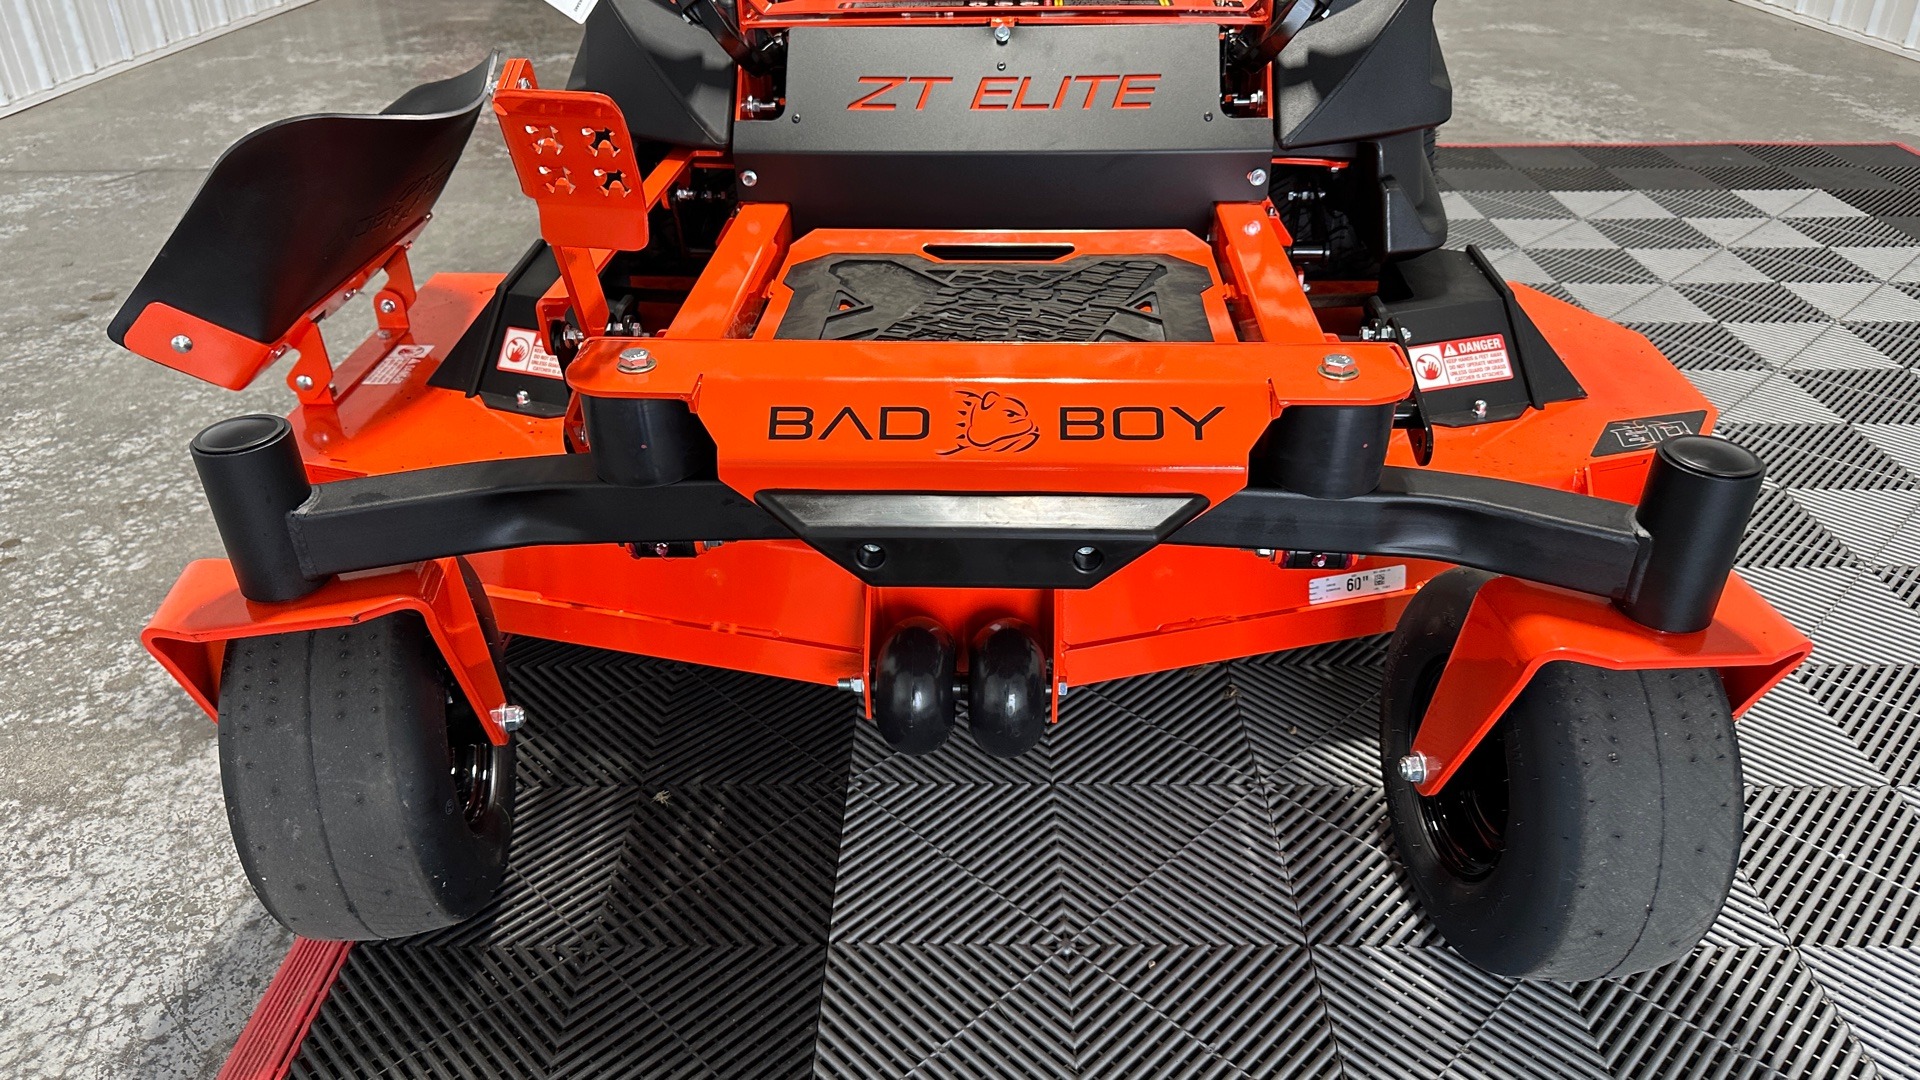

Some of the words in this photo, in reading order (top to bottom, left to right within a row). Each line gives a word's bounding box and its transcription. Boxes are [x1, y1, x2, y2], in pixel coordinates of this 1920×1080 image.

[846, 76, 954, 111] ZT
[970, 73, 1162, 111] ELITE
[1458, 338, 1502, 354] DANGER
[767, 406, 930, 441] BAD
[1058, 406, 1226, 441] BOY
[1346, 575, 1369, 592] 60"
